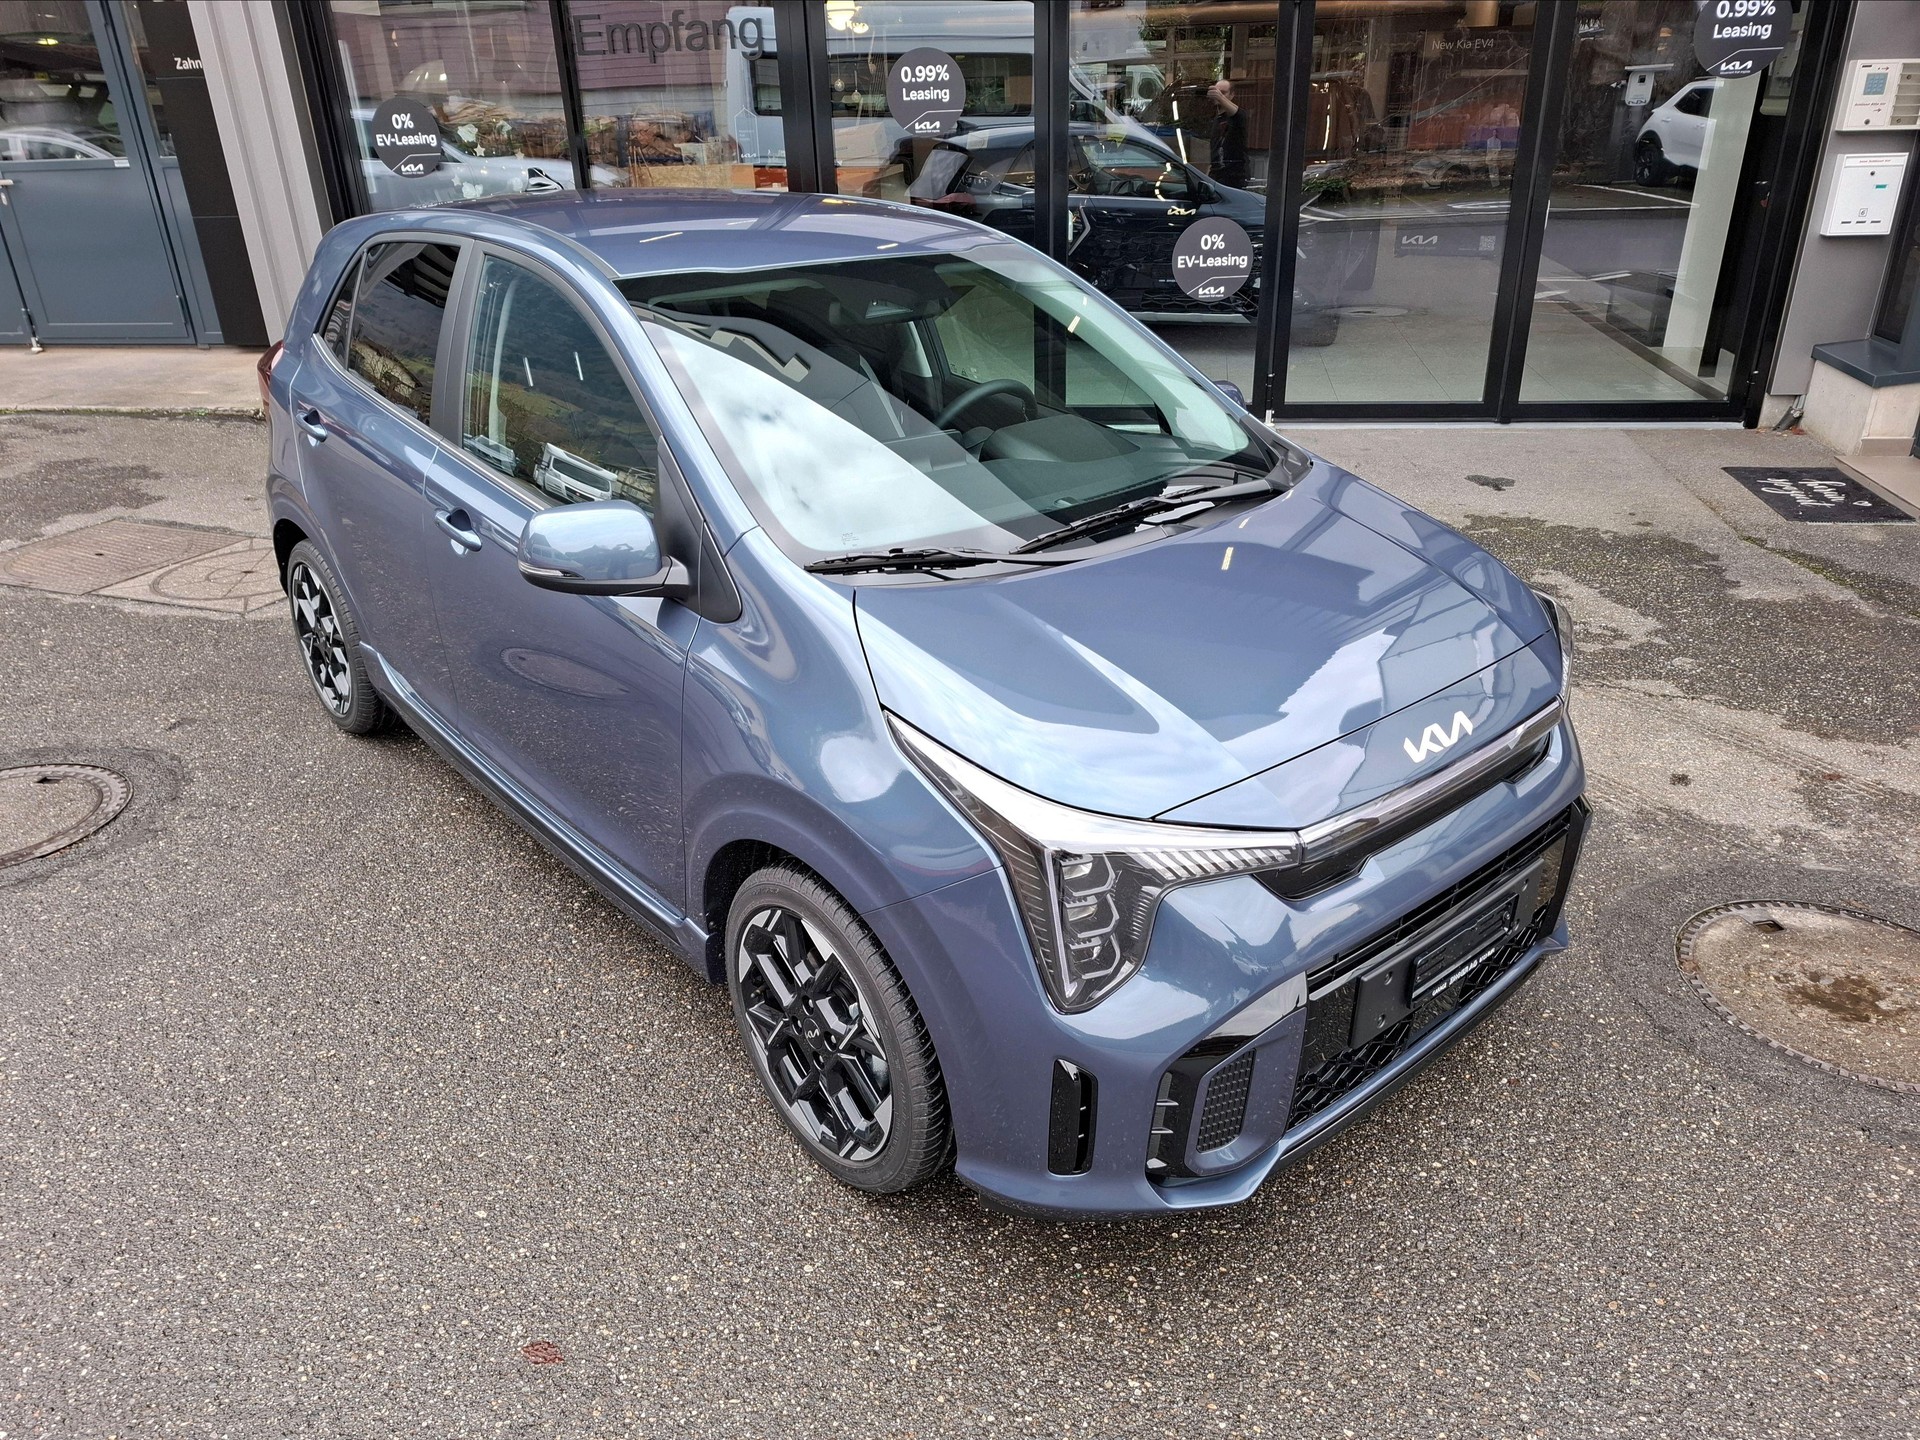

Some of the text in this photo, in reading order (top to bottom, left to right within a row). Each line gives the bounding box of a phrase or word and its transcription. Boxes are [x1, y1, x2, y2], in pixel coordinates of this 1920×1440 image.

[1716, 0, 1777, 19] 0.99%
[573, 9, 763, 64] Empfang
[1712, 21, 1773, 40] Leasing
[1431, 38, 1495, 51] New Kia EV4
[174, 57, 203, 70] Zahn
[900, 64, 950, 83] 0.99%
[902, 86, 950, 103] Leasing
[391, 113, 415, 129] 0%
[914, 121, 941, 130] KIA
[375, 132, 438, 147] EV-Leasing
[1200, 233, 1226, 251] 0%
[1401, 234, 1438, 245] KIA
[1177, 253, 1248, 268] EV-Leasing
[1198, 286, 1225, 295] KIA
[1403, 710, 1473, 763] KIA
